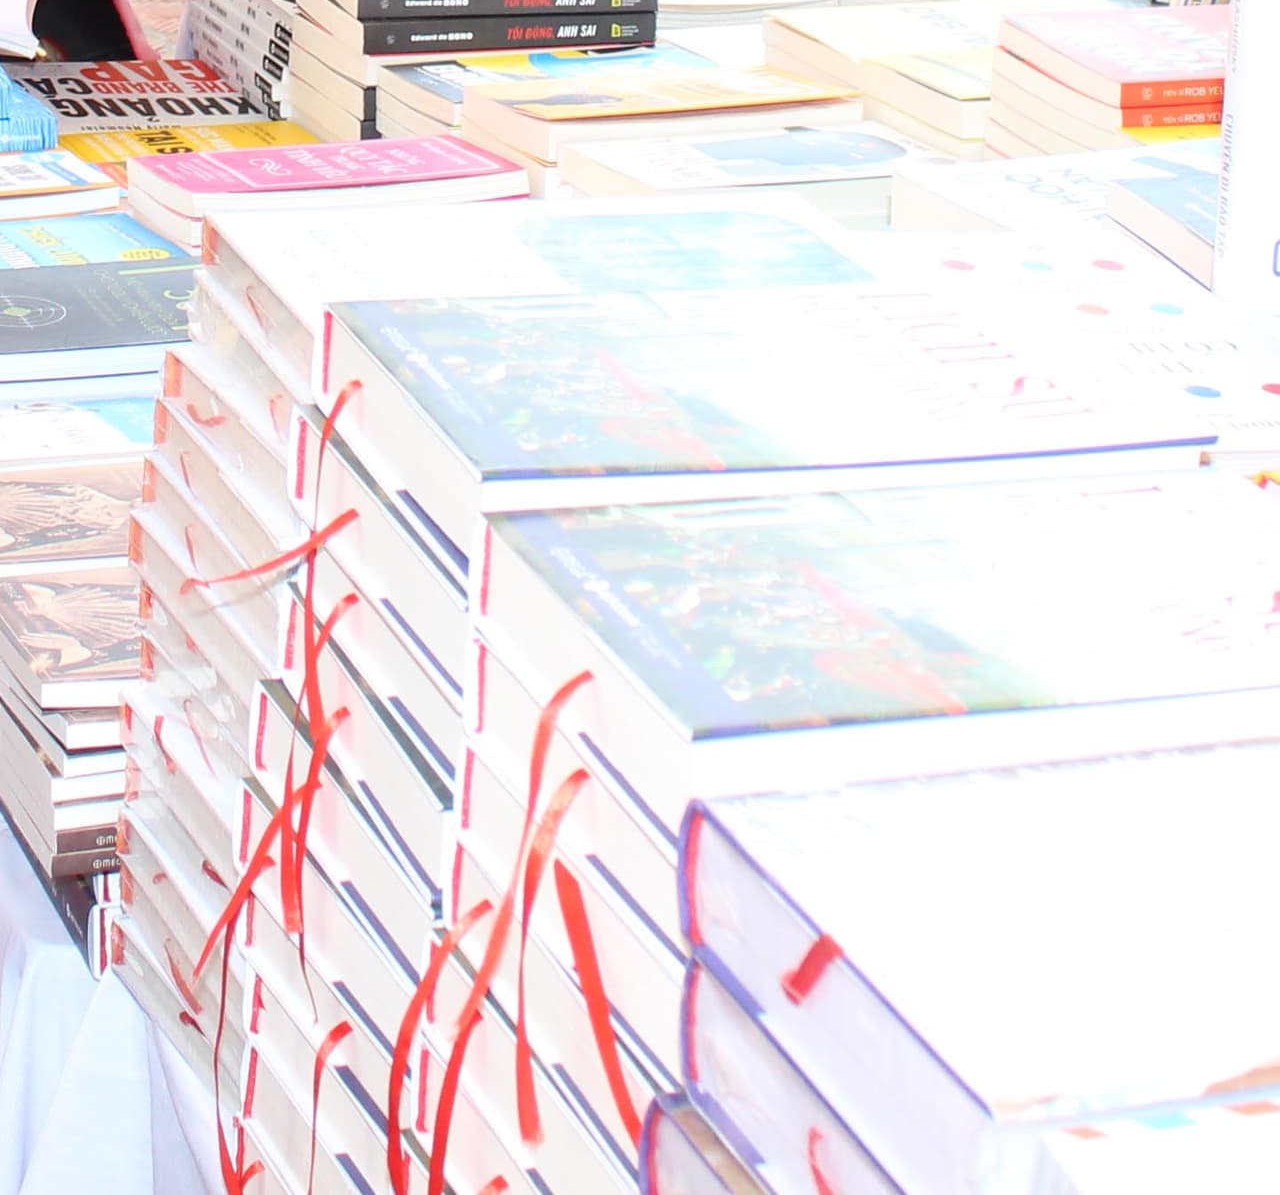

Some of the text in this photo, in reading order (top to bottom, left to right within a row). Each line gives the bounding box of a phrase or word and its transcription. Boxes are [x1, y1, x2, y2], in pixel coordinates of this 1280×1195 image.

[557, 25, 578, 37] ANH
[580, 24, 597, 37] SAI
[81, 59, 221, 82] GAP
[23, 77, 92, 100] CÁ
[92, 81, 238, 94] THE BRAND
[49, 95, 262, 123] KHOẢNG
